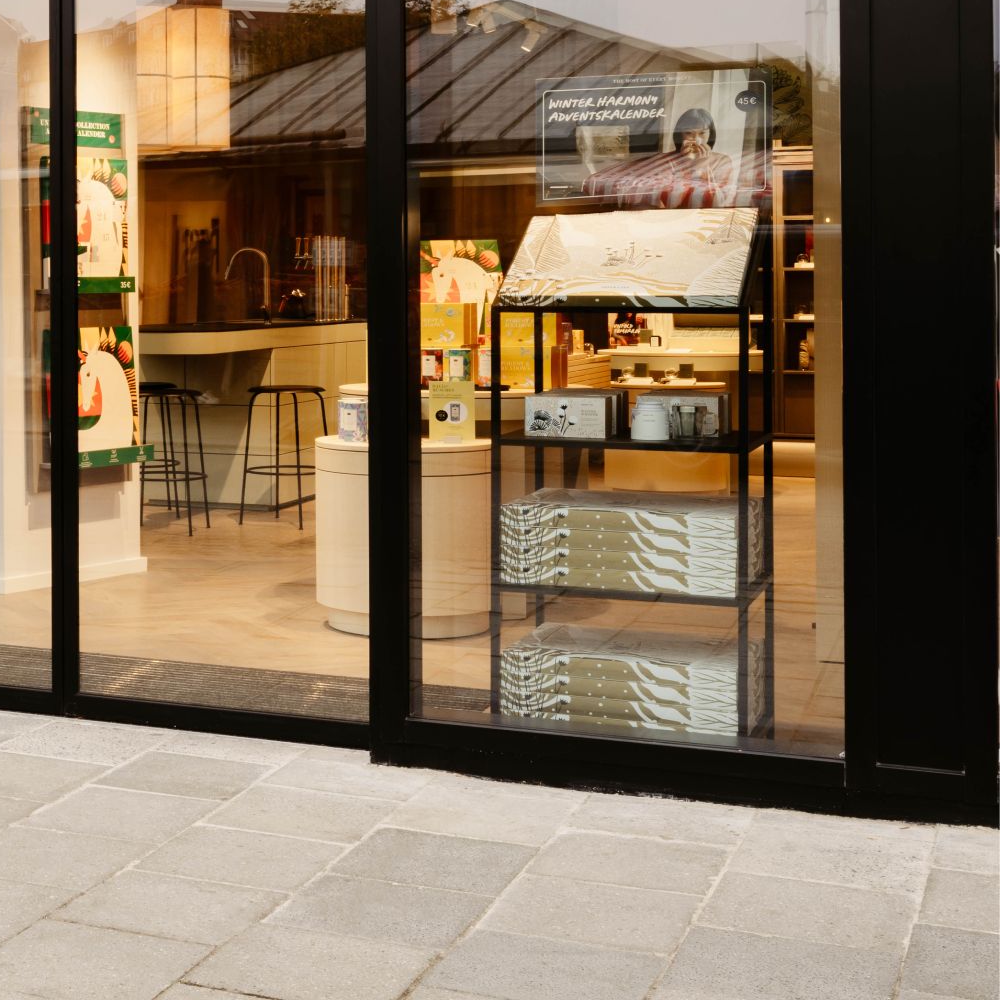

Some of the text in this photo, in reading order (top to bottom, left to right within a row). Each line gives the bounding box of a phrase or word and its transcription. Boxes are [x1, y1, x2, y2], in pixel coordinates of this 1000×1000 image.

[548, 95, 658, 109] WINTER HARMONY
[548, 108, 667, 122] ADVENTSKALENDER
[77, 121, 110, 130] OLLECTION
